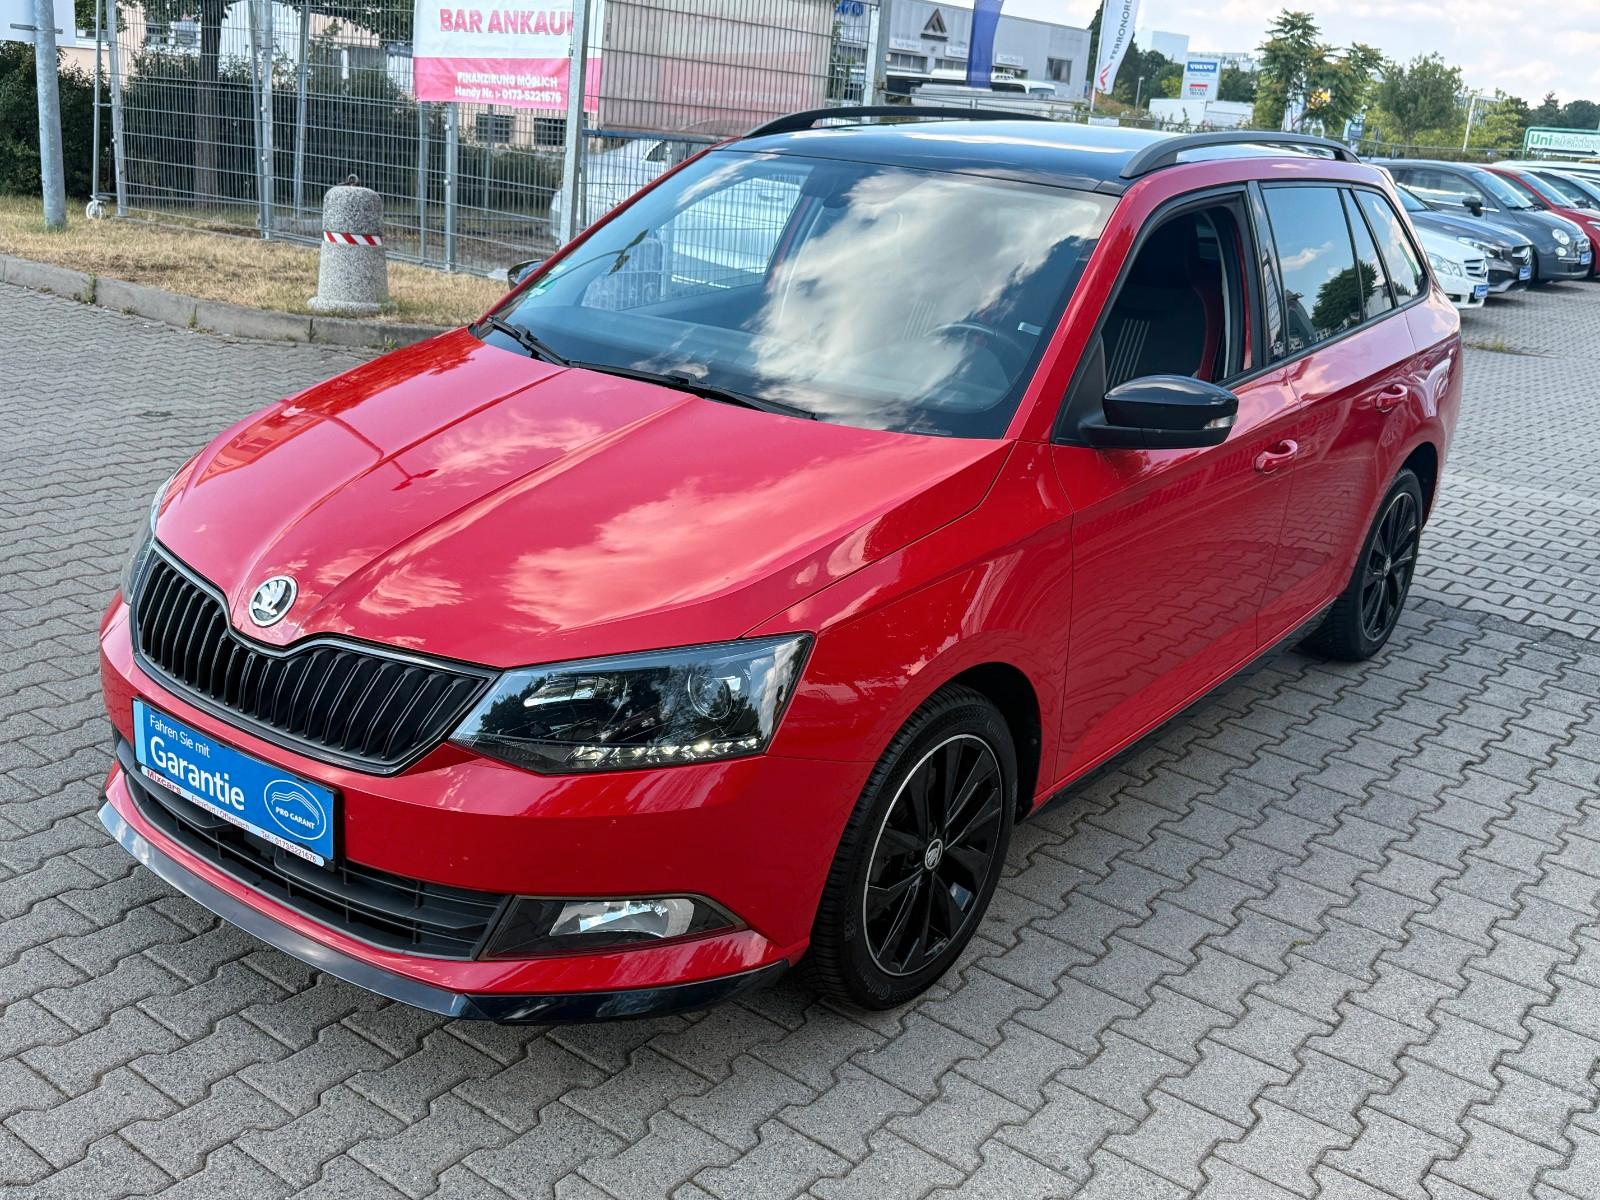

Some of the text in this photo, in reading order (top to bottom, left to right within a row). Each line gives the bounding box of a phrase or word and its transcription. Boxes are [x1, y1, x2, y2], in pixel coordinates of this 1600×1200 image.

[440, 8, 482, 33] BAR
[1189, 63, 1215, 72] VOLVO
[454, 85, 481, 100] Handy
[482, 87, 494, 98] Nr.
[517, 73, 558, 88] MÖGLICH
[150, 714, 211, 758] Fahren Sie mit
[146, 769, 182, 795] Mixcars
[150, 735, 245, 811] Garantie
[275, 806, 316, 830] PRO GARANT
